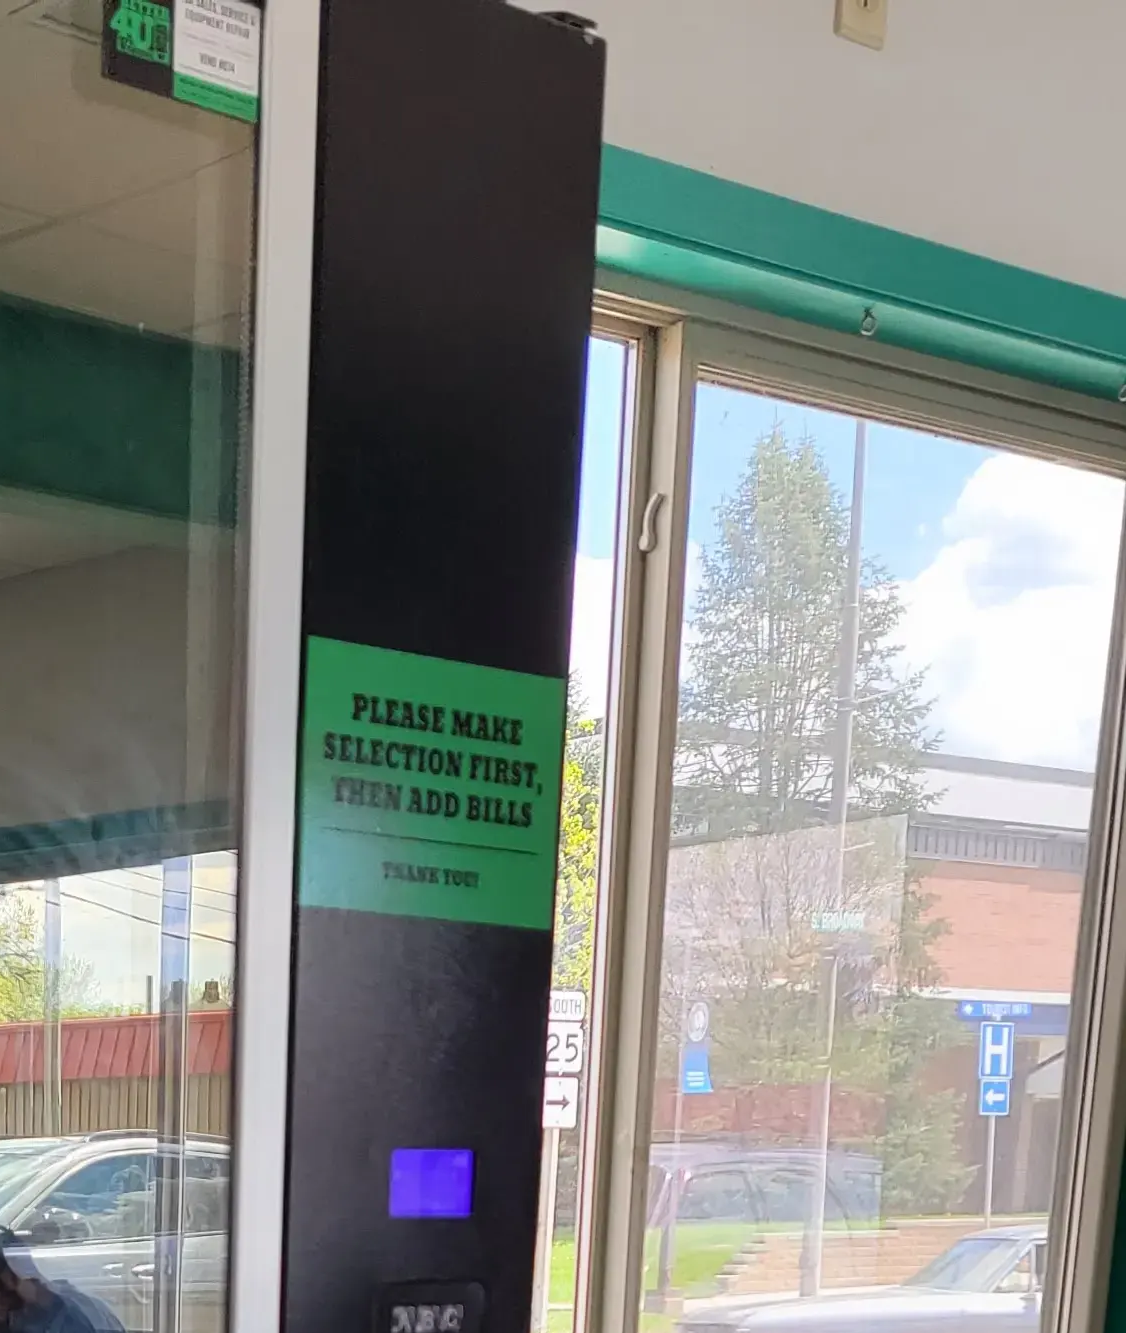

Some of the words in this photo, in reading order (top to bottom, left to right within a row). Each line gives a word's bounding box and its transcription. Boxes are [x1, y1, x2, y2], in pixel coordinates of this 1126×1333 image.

[351, 692, 445, 734] PLEASE
[451, 708, 524, 746] MAKE
[323, 731, 463, 779] SELECTION
[469, 752, 543, 796] FIRST,
[332, 775, 403, 811] THEN
[406, 786, 460, 818] ADD
[465, 795, 534, 829] BILLS
[381, 861, 438, 885] THANK
[550, 998, 582, 1014] OUTH
[546, 1032, 579, 1063] 25
[983, 1025, 1010, 1076] H
